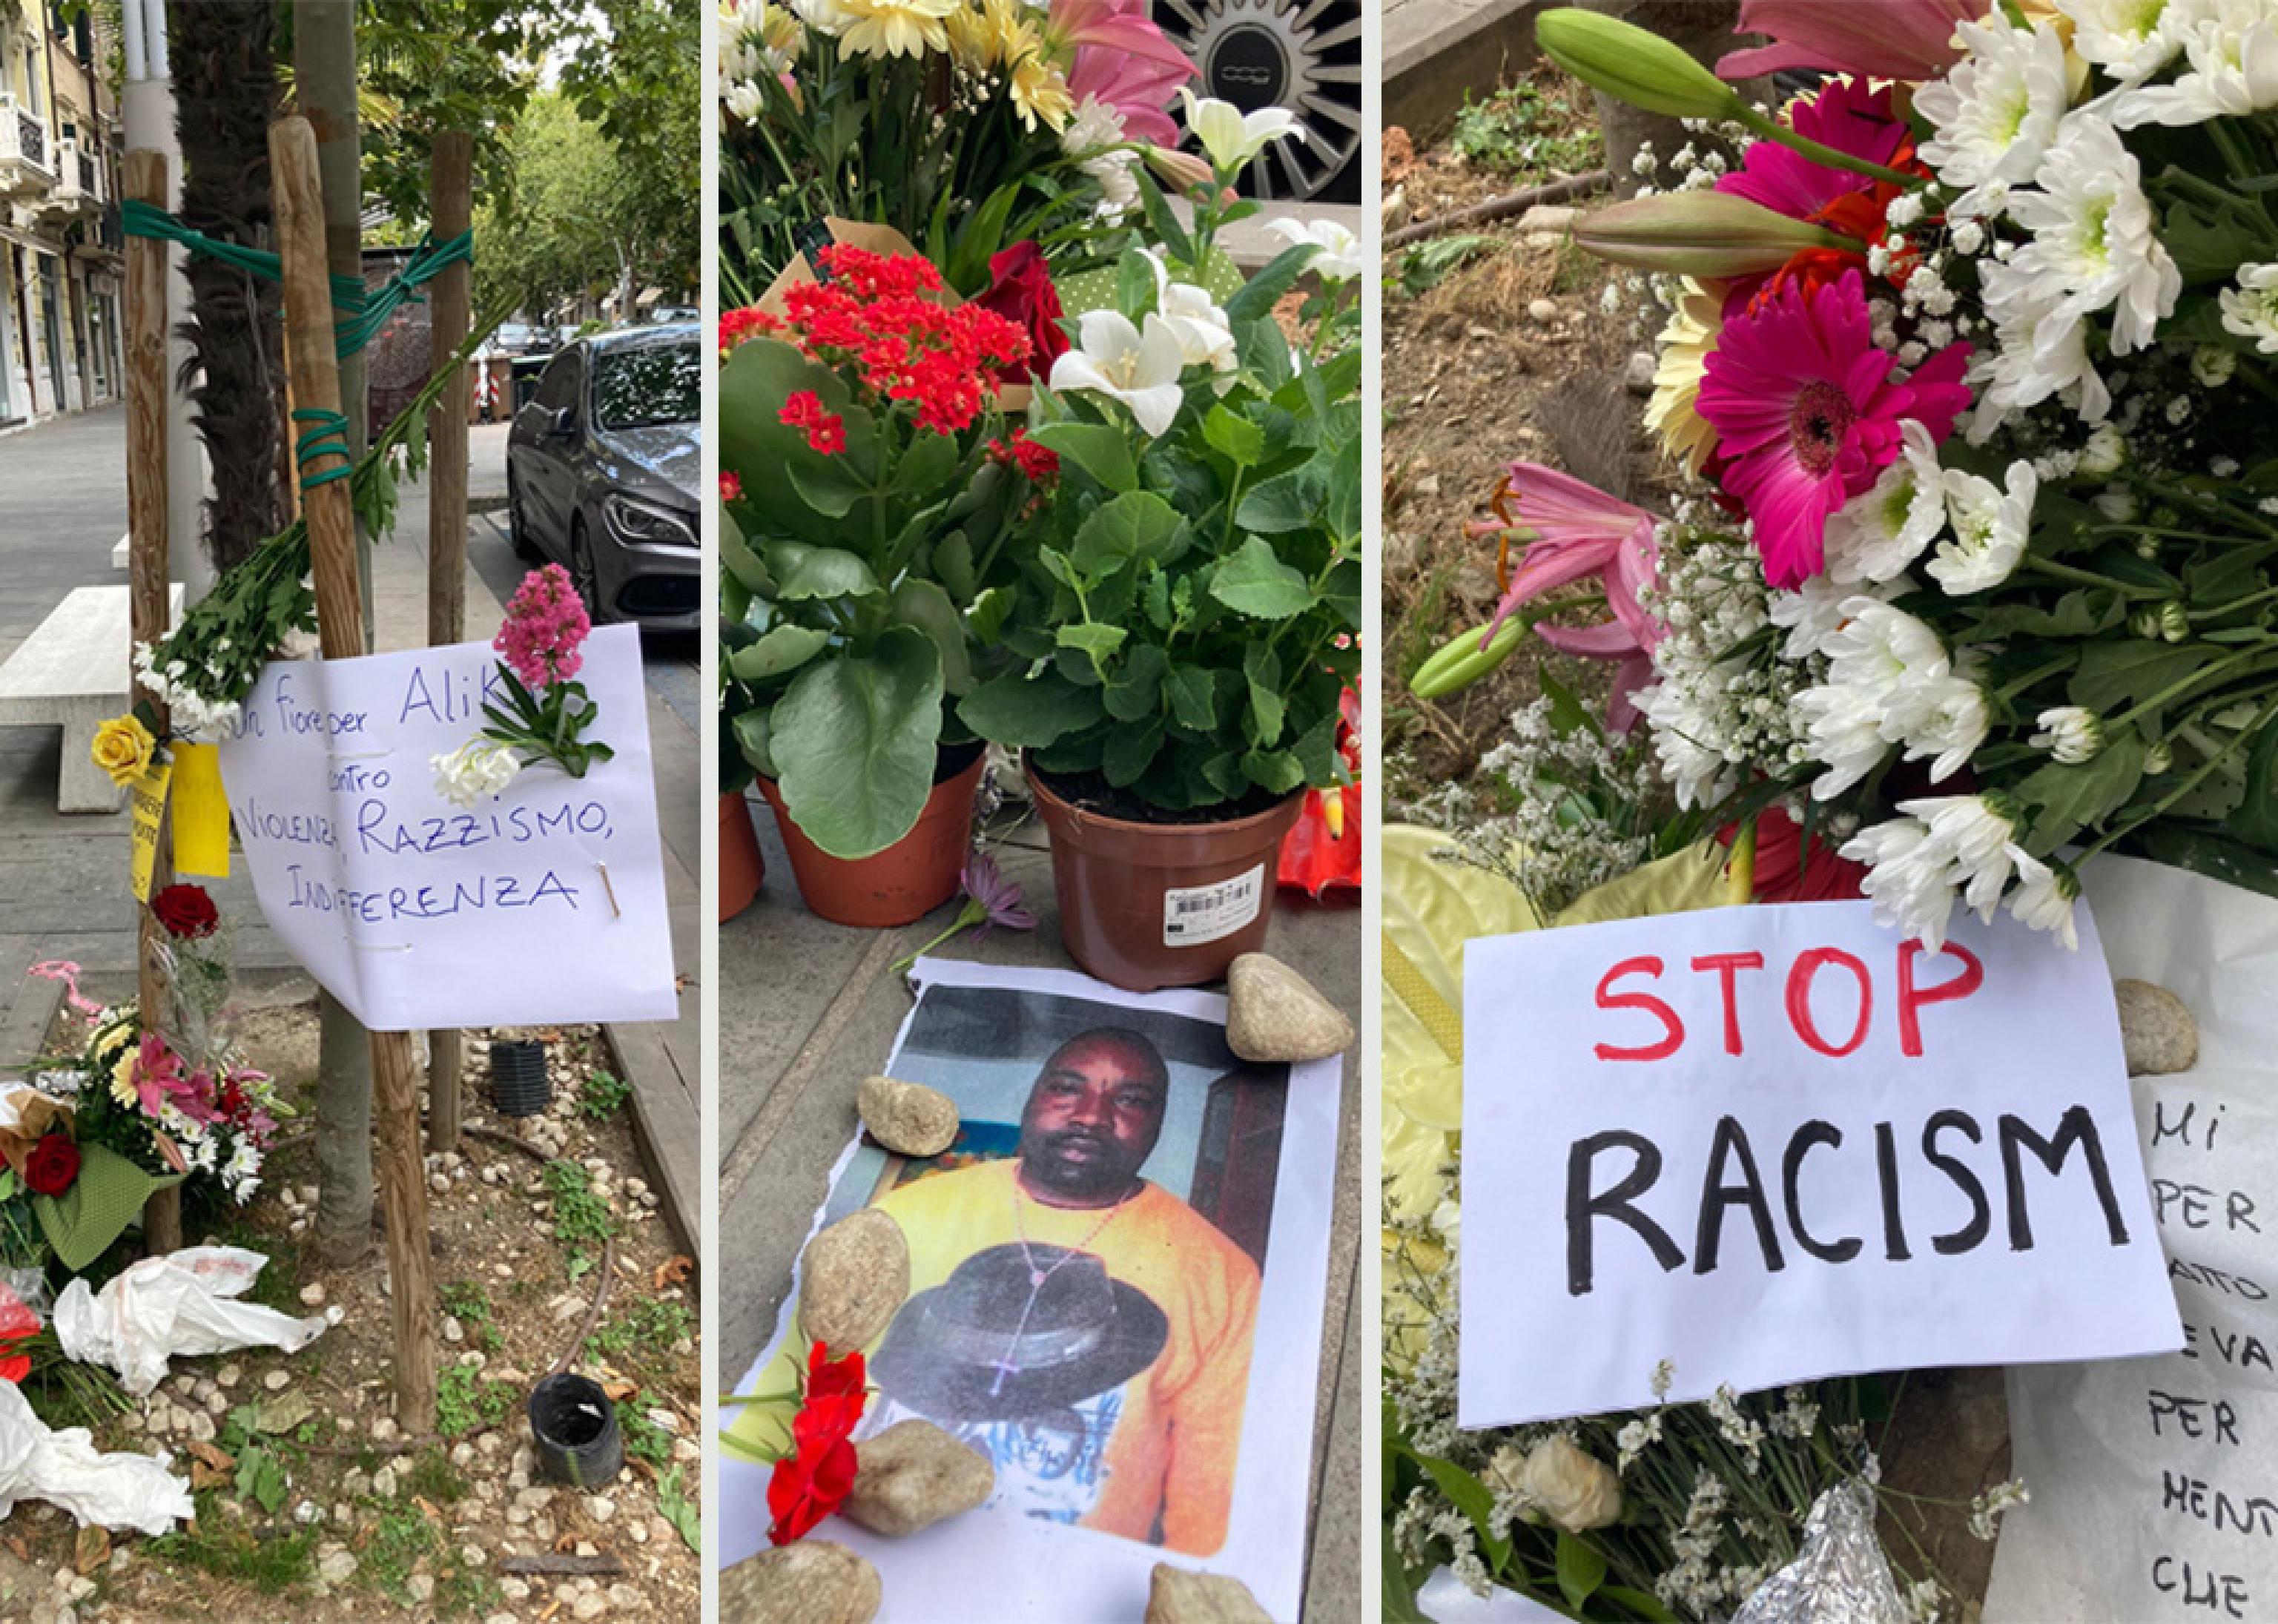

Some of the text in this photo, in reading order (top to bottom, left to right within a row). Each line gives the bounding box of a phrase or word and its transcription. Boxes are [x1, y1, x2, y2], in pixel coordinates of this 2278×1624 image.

[1594, 937, 1984, 1061] STOP
[1565, 1105, 2130, 1296] RACISM
[2152, 1178, 2261, 1234] PER
[2168, 1258, 2269, 1299] ATTO
[2181, 1323, 2274, 1373] EVA
[2148, 1390, 2241, 1446] PER
